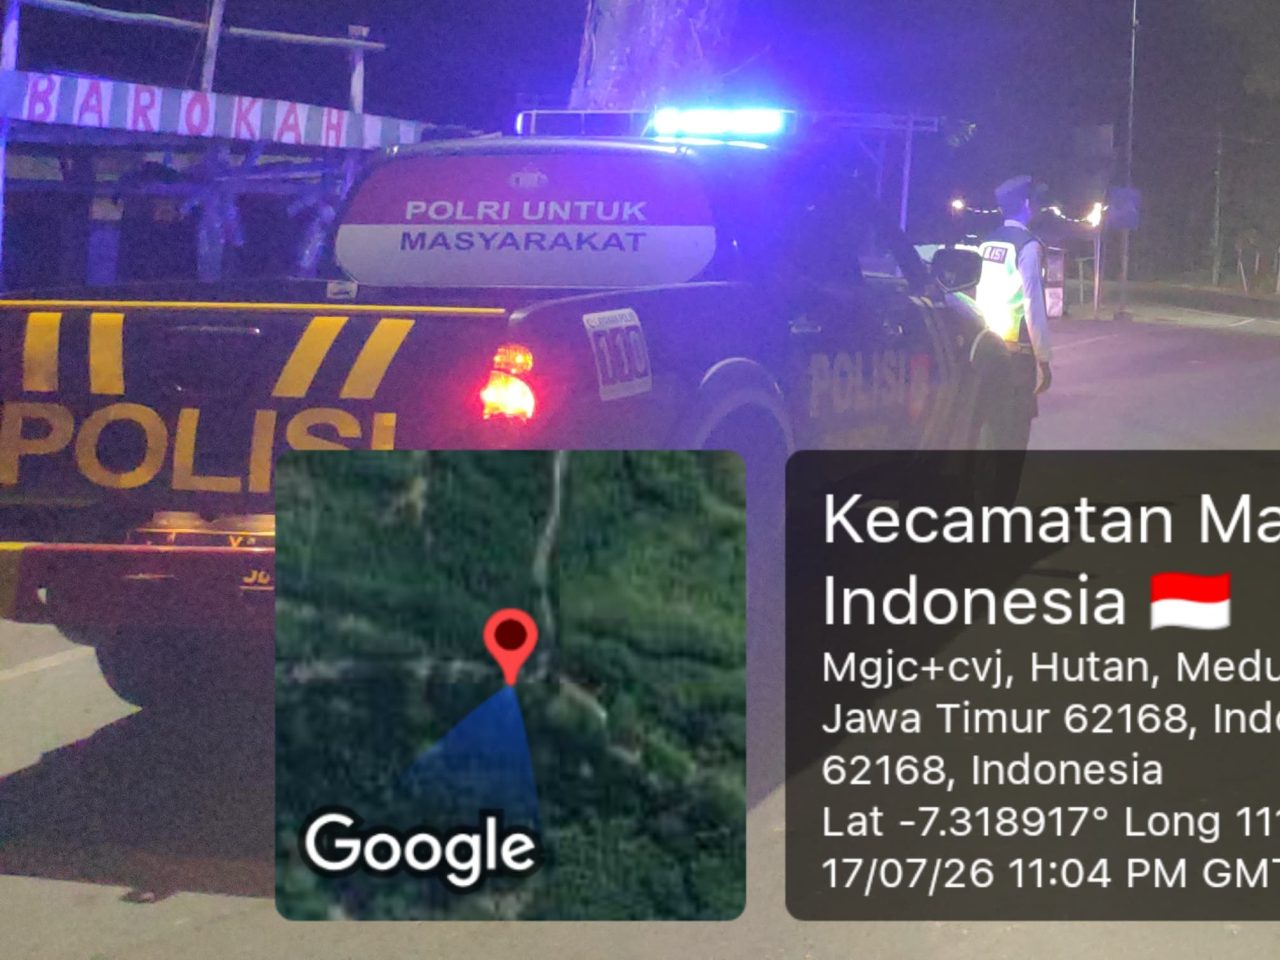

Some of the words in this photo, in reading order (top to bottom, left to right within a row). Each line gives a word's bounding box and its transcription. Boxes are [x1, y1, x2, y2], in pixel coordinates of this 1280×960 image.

[26, 75, 345, 147] BAROKAH
[404, 200, 511, 222] POLRI
[522, 200, 648, 222] UNTUK
[400, 230, 648, 253] MASYARAKAT
